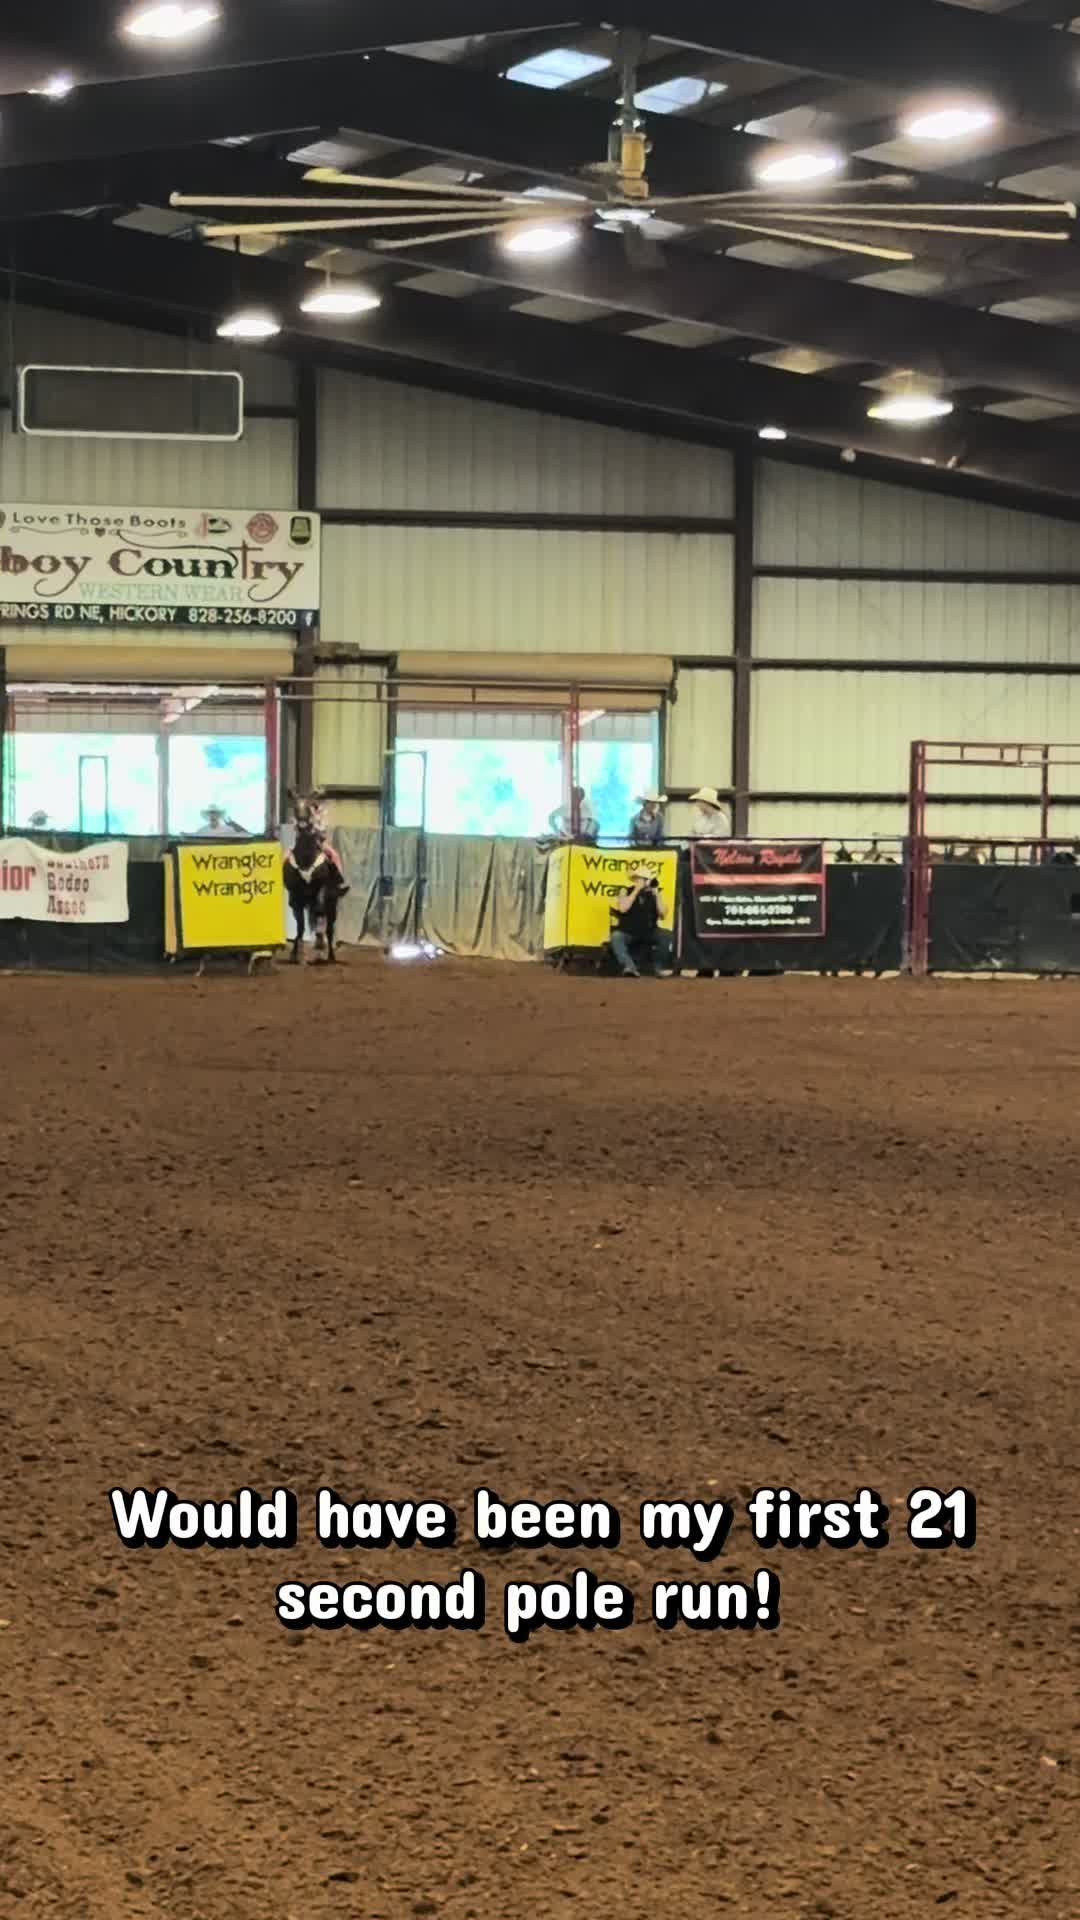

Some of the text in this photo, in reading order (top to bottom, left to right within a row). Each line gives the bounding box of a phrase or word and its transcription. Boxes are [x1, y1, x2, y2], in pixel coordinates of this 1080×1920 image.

[13, 511, 187, 529] Love Those Boots
[107, 539, 305, 603] Country
[79, 583, 243, 602] WESTERN WEAR
[0, 603, 49, 620] RINGS
[54, 605, 75, 620] RD
[110, 606, 178, 624] HICKORY
[188, 608, 297, 626] 828-256-8200
[191, 852, 275, 878] Wrangler
[192, 878, 276, 904] Wrangler
